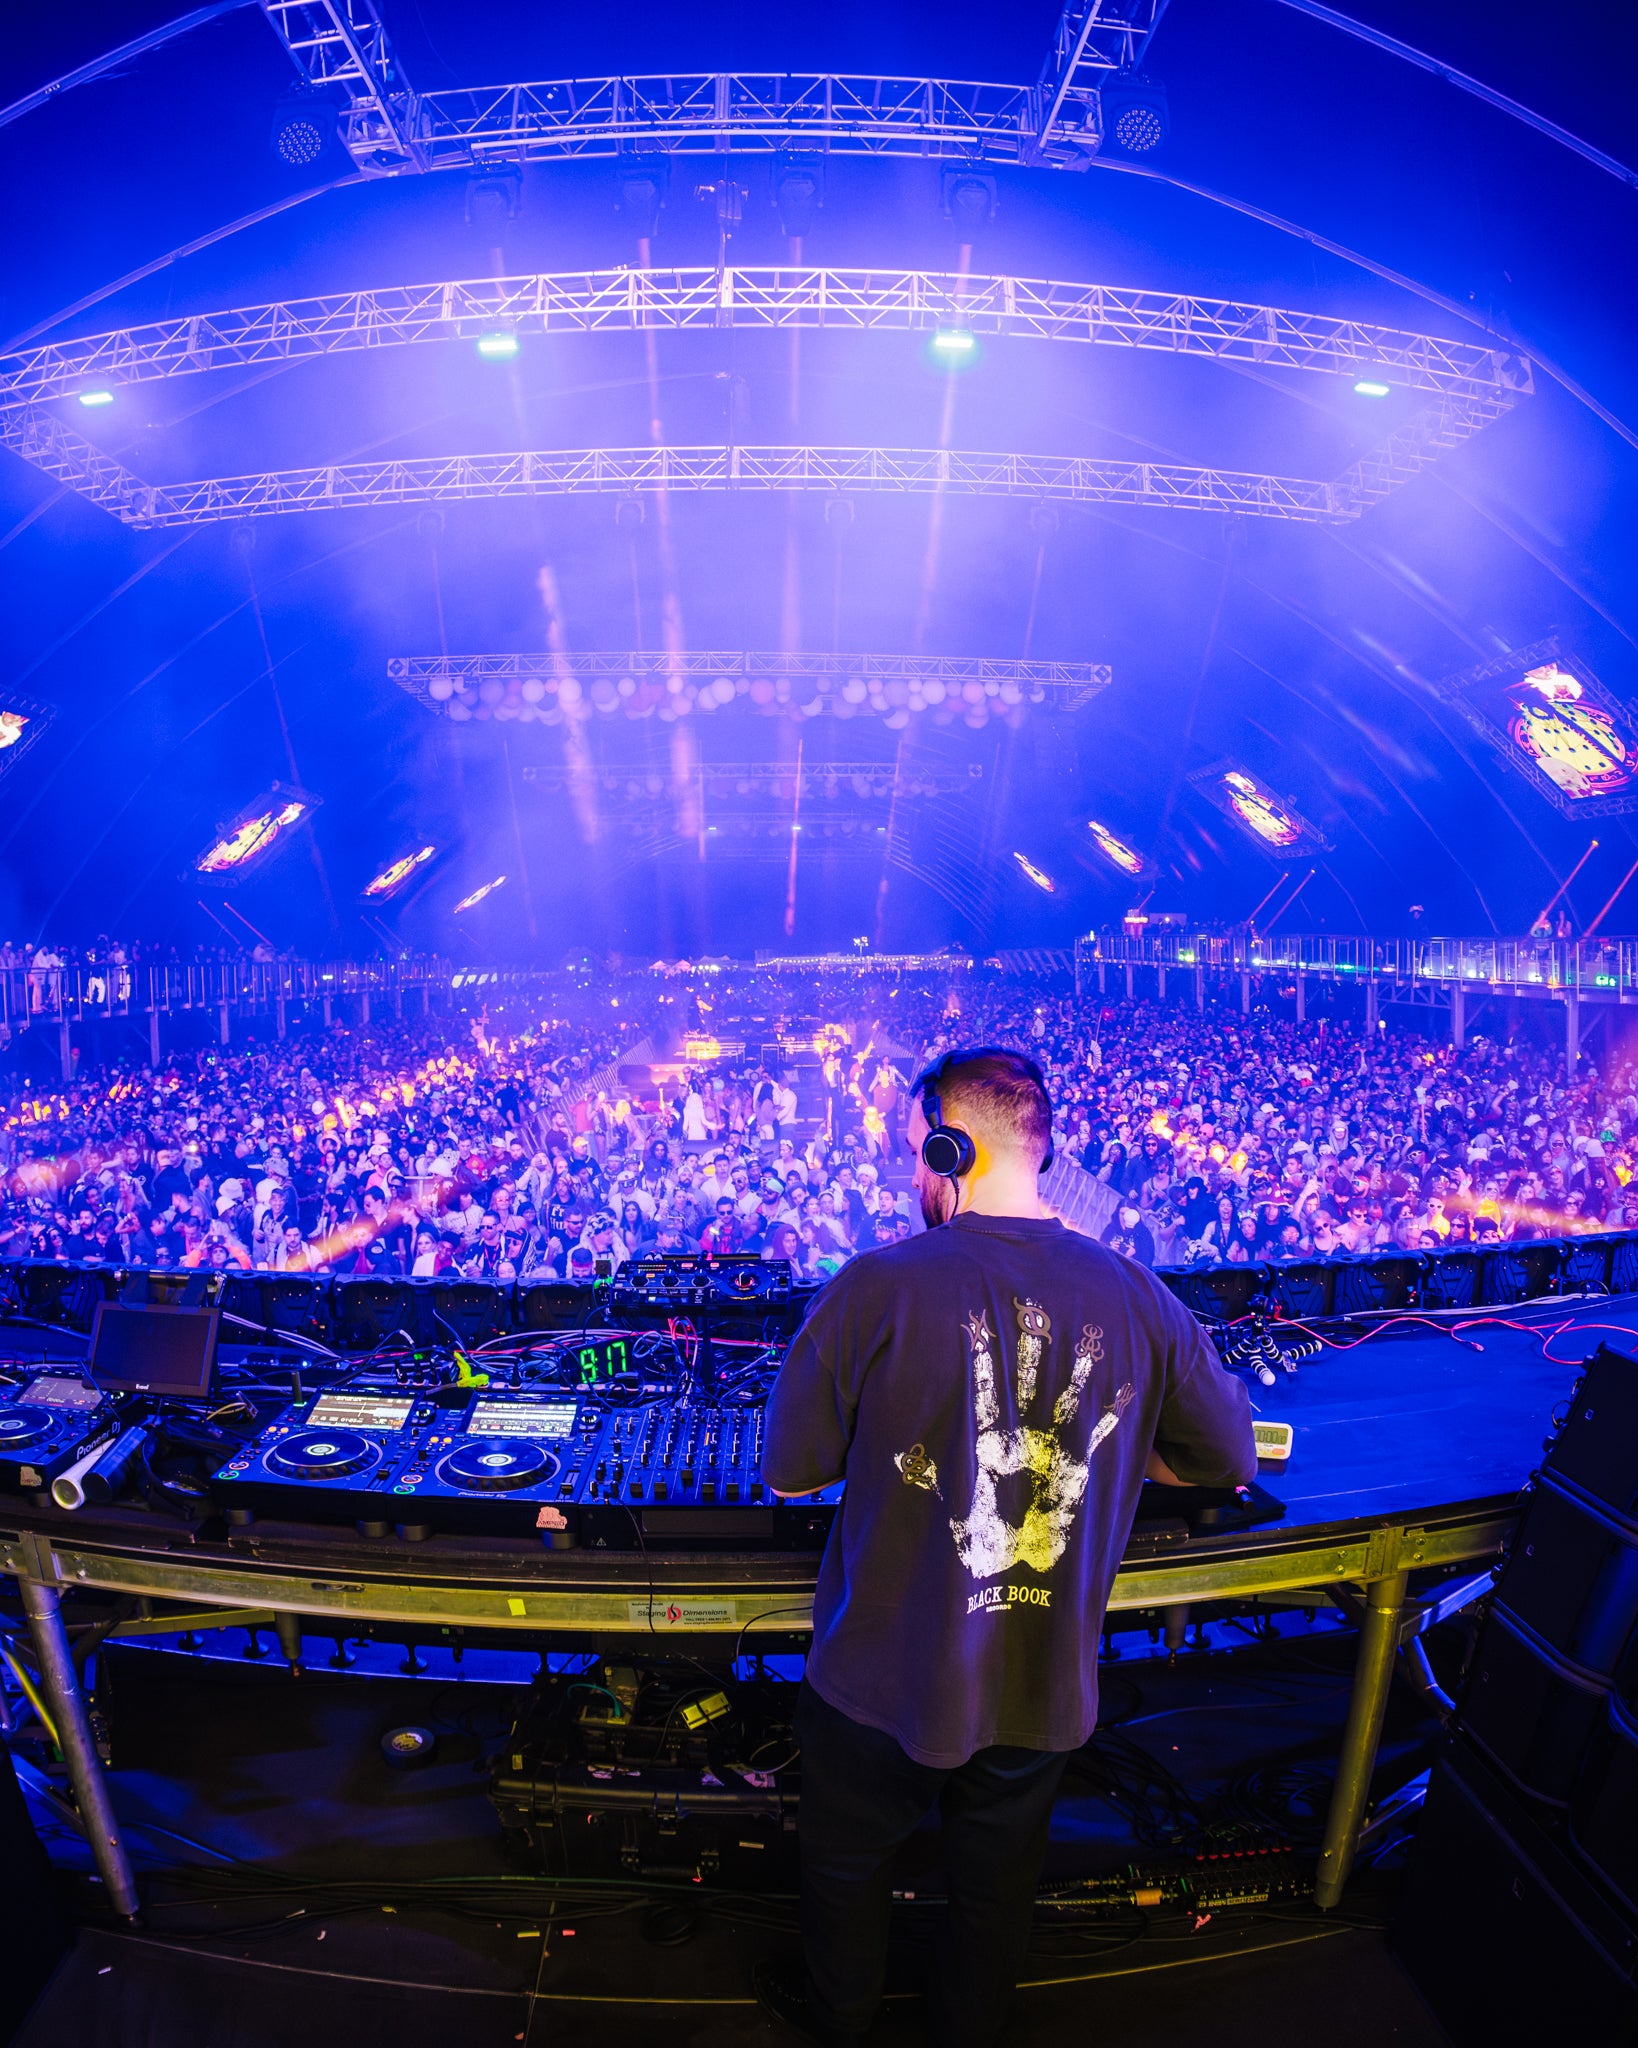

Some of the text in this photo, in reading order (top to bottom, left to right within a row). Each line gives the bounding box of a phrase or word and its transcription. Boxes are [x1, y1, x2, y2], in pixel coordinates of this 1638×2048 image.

[966, 1585, 1052, 1614] BLACK BOOK
[637, 1610, 666, 1618] Staging
